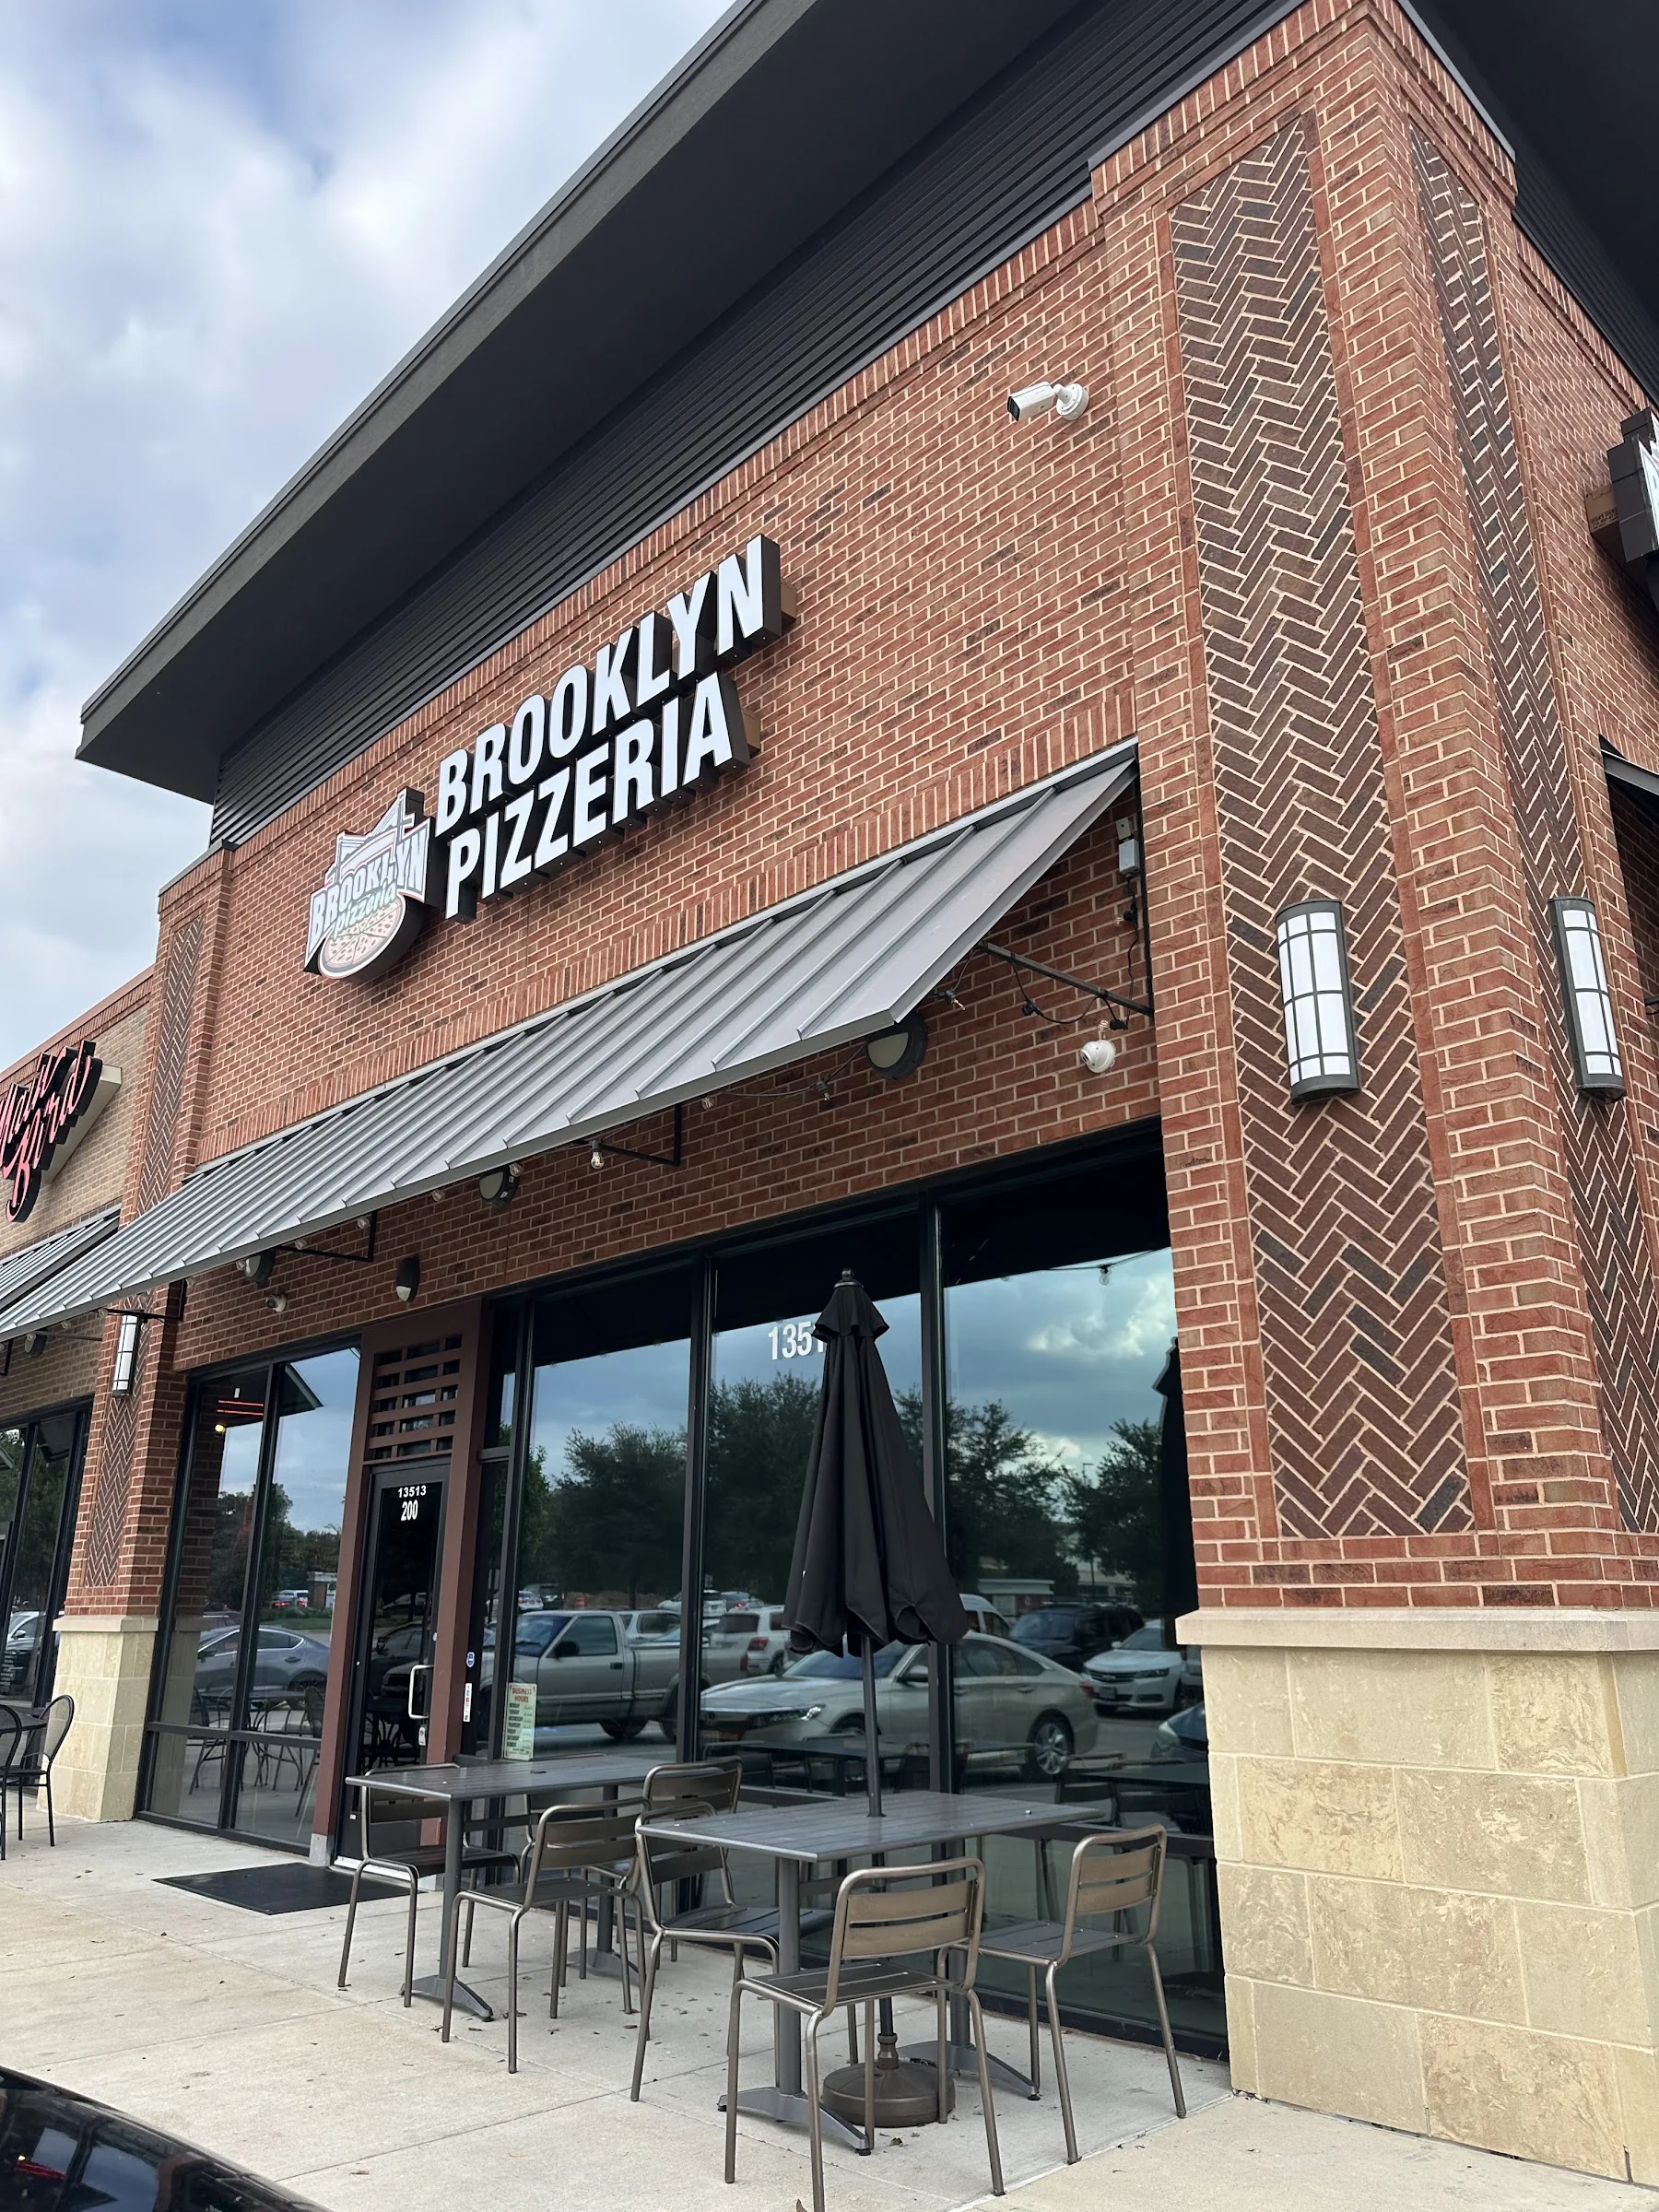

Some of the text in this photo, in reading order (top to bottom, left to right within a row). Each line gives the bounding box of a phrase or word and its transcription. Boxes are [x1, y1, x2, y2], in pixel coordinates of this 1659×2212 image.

[436, 534, 763, 837] BROOKLYN
[445, 670, 734, 920] PIZZERIA
[308, 828, 427, 958] BROOKLYN
[333, 879, 397, 941] pizzeria
[398, 1485, 427, 1499] 13513
[401, 1500, 418, 1521] 200
[514, 1695, 529, 1703] HOURS
